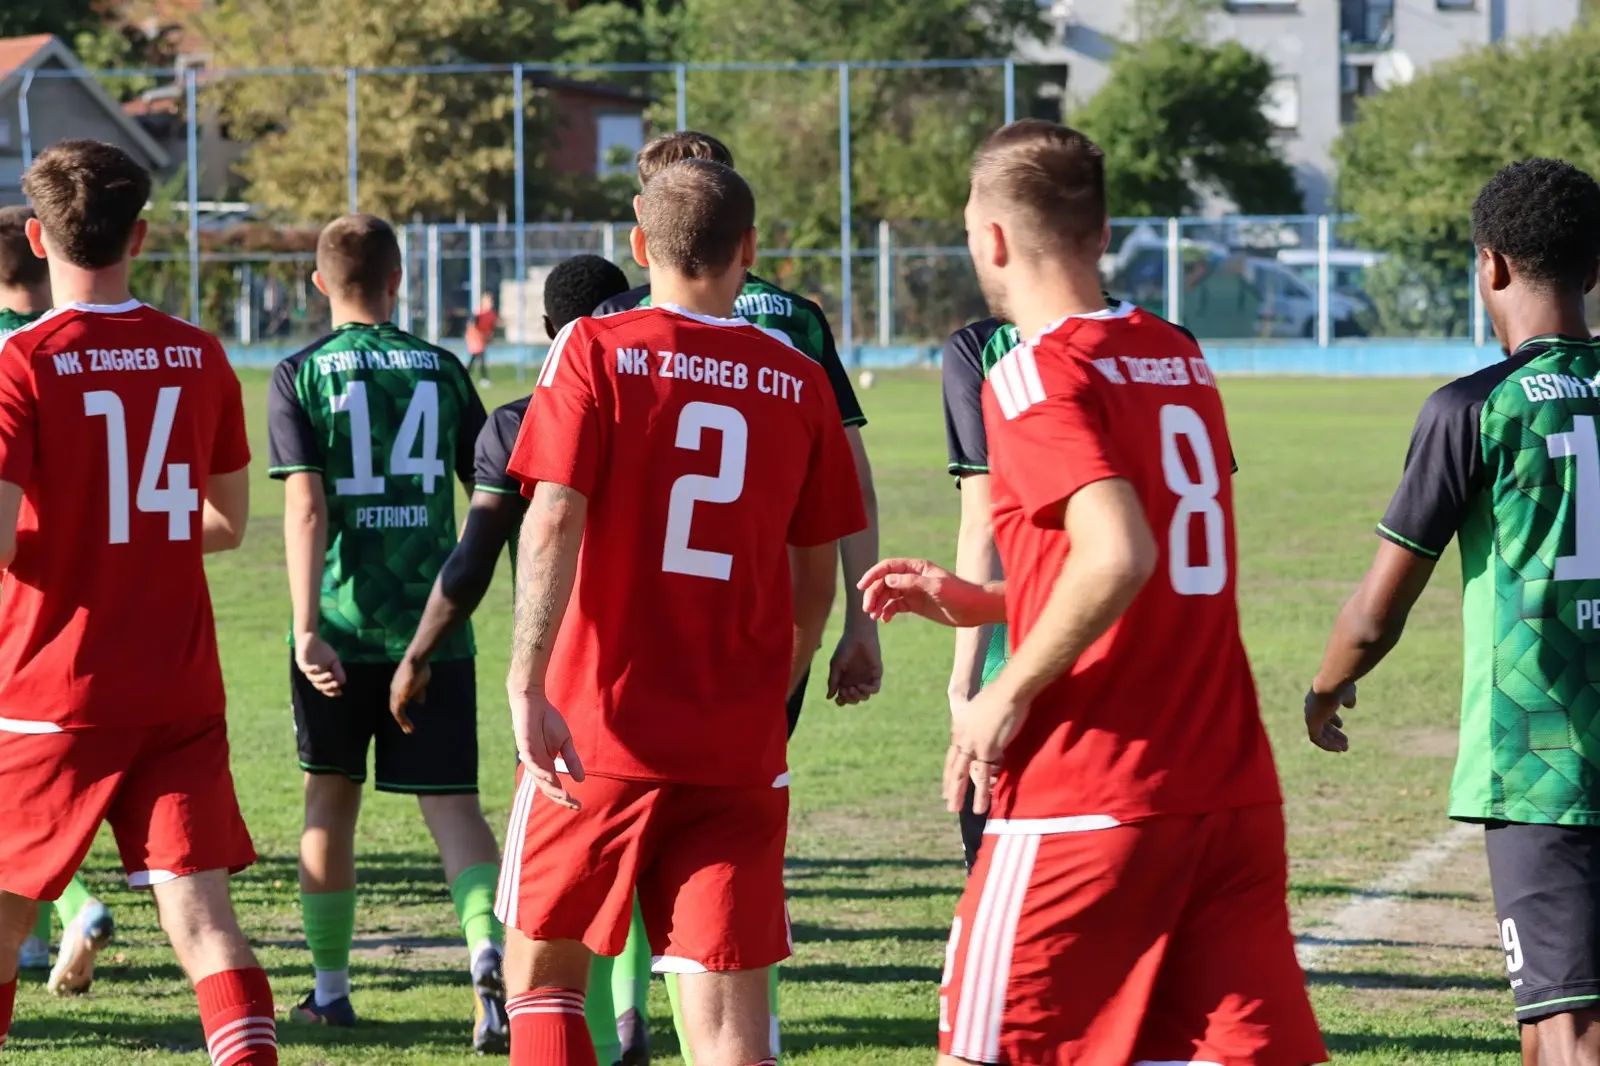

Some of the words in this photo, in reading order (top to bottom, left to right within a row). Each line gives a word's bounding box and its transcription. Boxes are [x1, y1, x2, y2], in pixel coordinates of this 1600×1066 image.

[732, 293, 792, 317] ADOST
[52, 351, 83, 376] NK
[85, 348, 160, 372] ZAGREB
[164, 345, 203, 369] CITY
[365, 349, 440, 371] MLADOST
[616, 347, 648, 375] NK
[657, 350, 749, 390] ZAGREB
[757, 366, 804, 403] CITY
[1520, 373, 1588, 402] GSNK
[330, 380, 445, 495] 14
[83, 386, 198, 544] 14
[662, 401, 748, 581] 2
[1159, 404, 1228, 595] 8
[356, 505, 428, 529] PETRINJA
